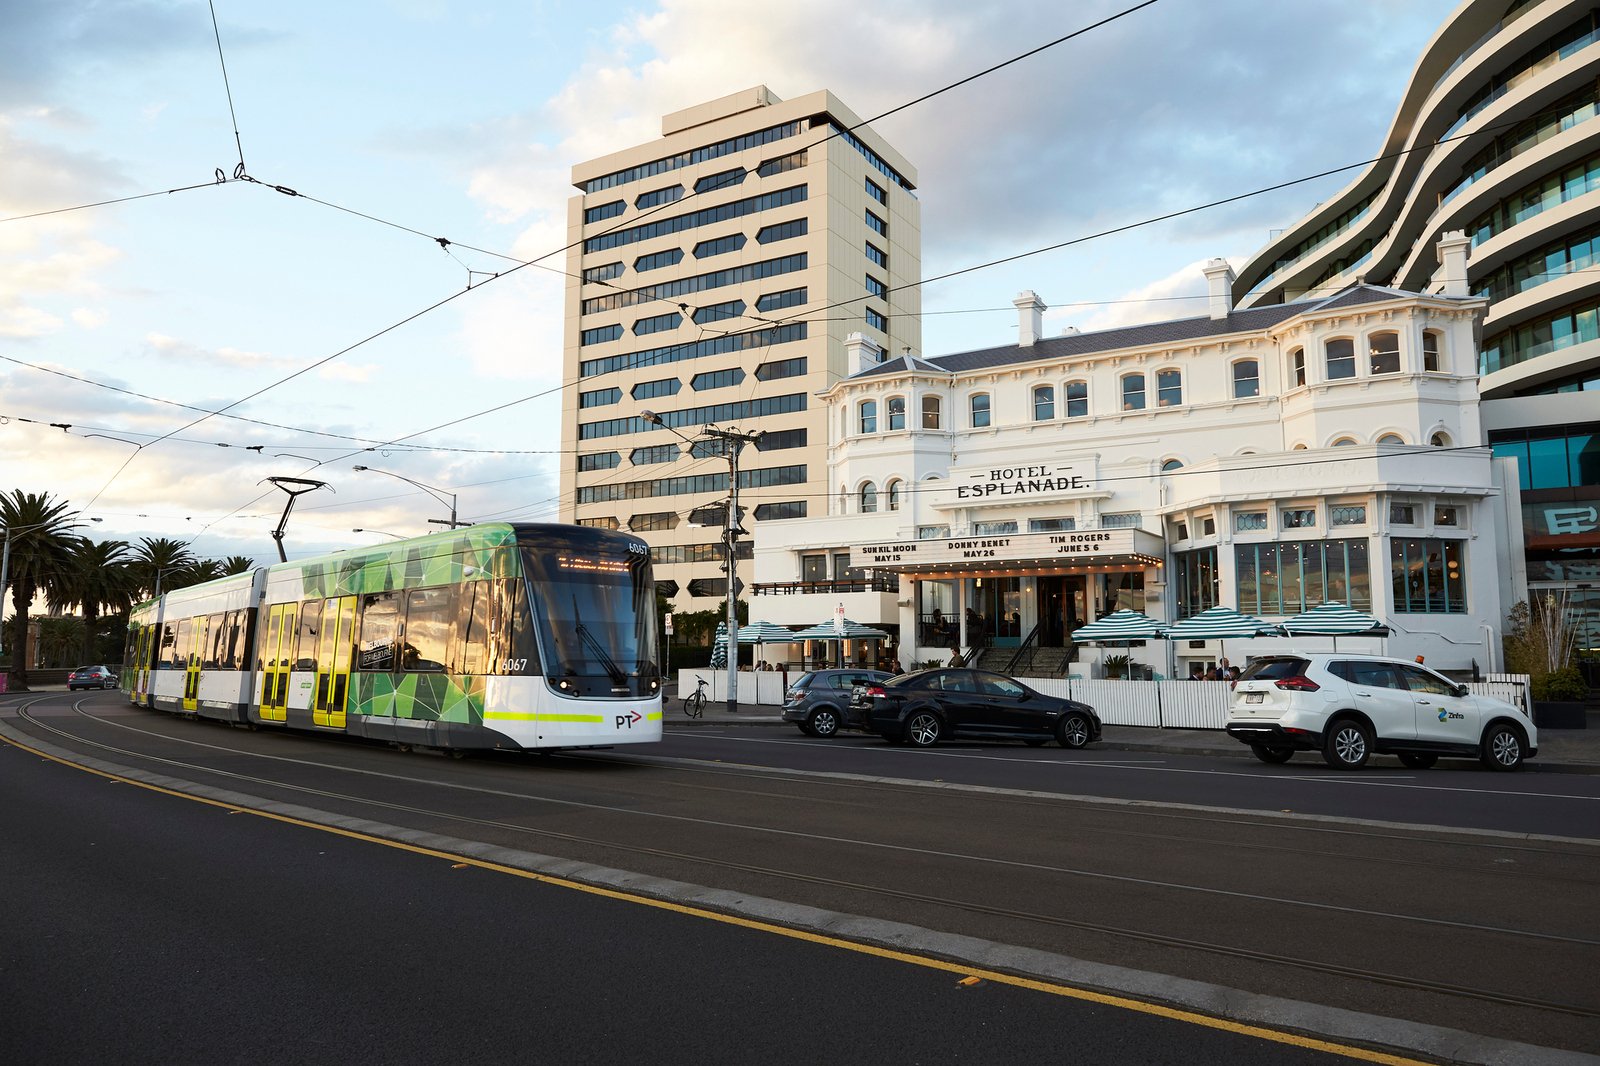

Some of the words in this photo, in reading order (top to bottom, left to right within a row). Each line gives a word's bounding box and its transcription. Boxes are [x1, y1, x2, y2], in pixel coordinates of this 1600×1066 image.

[990, 466, 1051, 480] HOTEL
[958, 476, 1090, 498] ESPLANADE.
[1049, 535, 1066, 543] TIM
[1070, 533, 1110, 543] ROGERS
[628, 542, 647, 556] 6067
[862, 546, 877, 554] SUN
[892, 544, 917, 553] MOON
[948, 541, 978, 549] DONNY
[981, 539, 1010, 548] BENET
[1057, 544, 1082, 553] JUNE
[1083, 544, 1090, 552] 5
[1092, 544, 1099, 552] 6
[963, 550, 981, 558] MAY
[983, 549, 995, 557] 26
[502, 658, 528, 671] 6067
